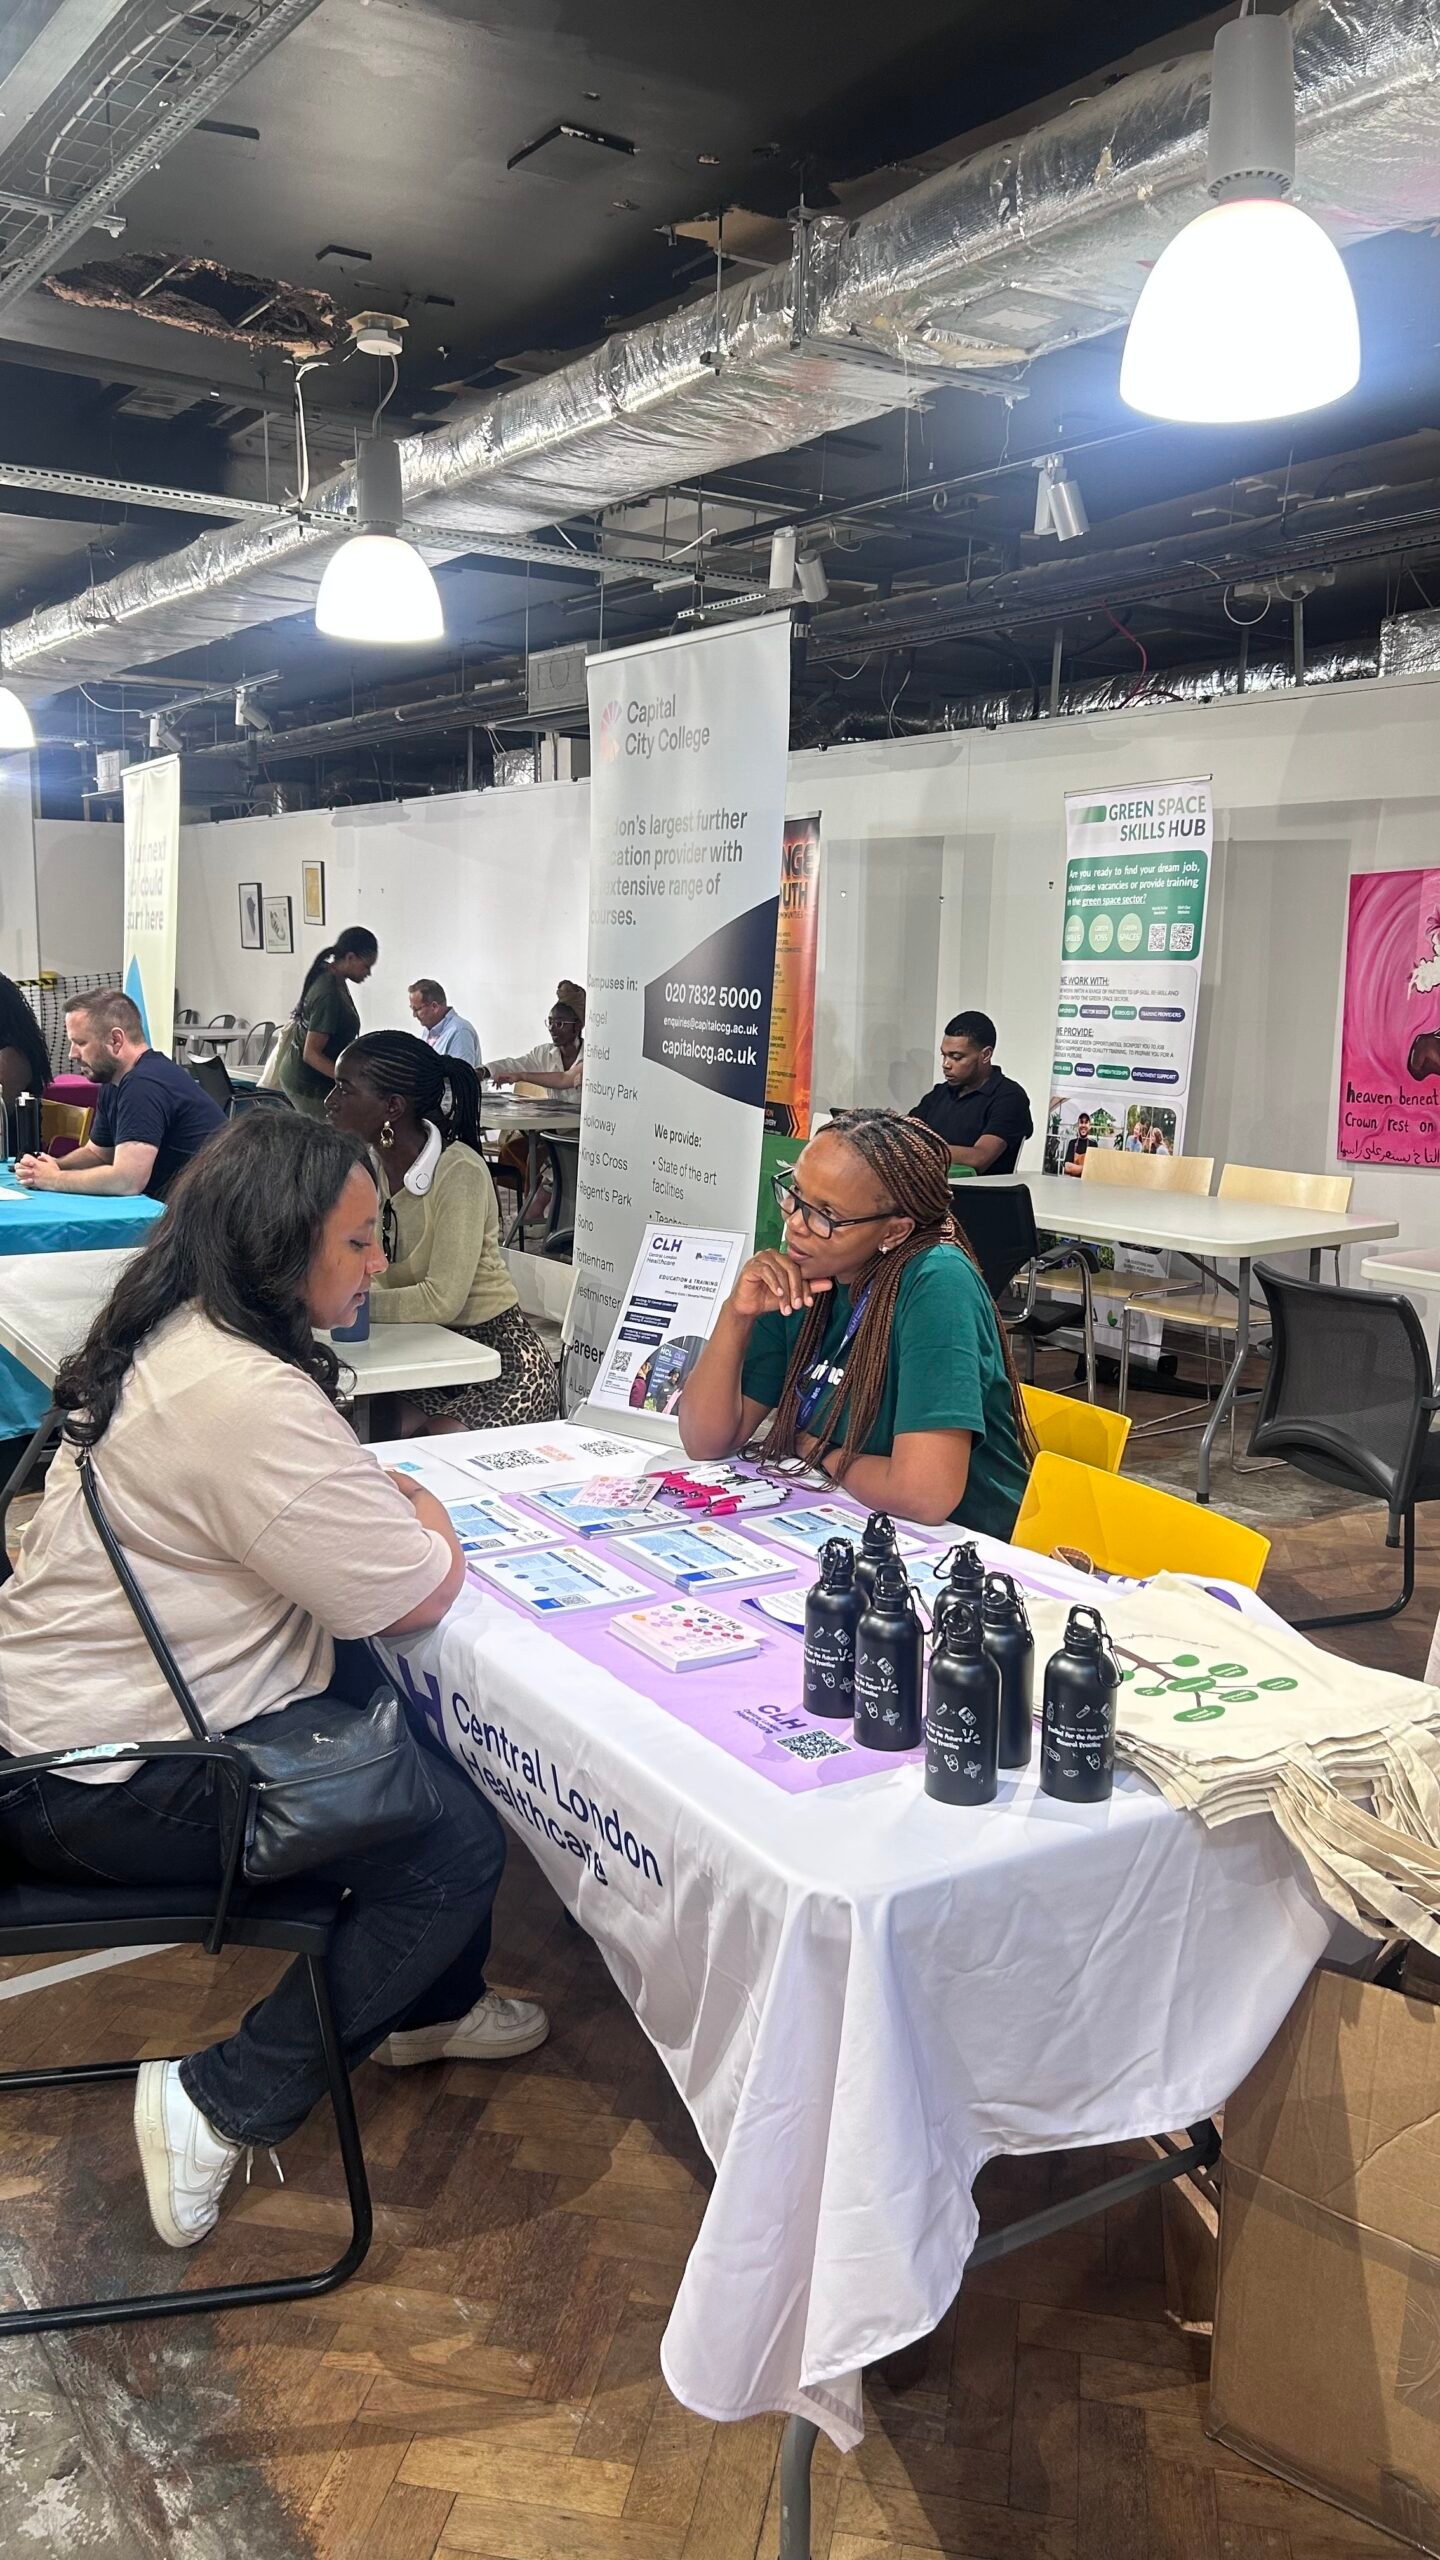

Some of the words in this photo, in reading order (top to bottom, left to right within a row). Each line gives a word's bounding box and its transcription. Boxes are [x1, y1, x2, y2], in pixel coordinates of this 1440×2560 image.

[627, 694, 676, 727] Capital
[625, 733, 655, 759] City
[658, 725, 710, 752] College
[1109, 800, 1154, 821] GREEN
[1158, 795, 1207, 816] SPACE
[650, 813, 693, 839] largest
[697, 808, 748, 831] further
[1120, 821, 1165, 841] SKILLS
[1168, 819, 1206, 837] HUB
[654, 842, 707, 870] provider
[710, 840, 743, 863] with
[1079, 870, 1091, 879] you
[1094, 867, 1113, 878] ready
[1115, 868, 1122, 876] to
[1124, 865, 1138, 875] find
[1140, 865, 1155, 876] your
[1158, 863, 1180, 873] dream
[1182, 861, 1200, 873] job,
[604, 875, 666, 897] extensive
[668, 878, 703, 900] range
[706, 873, 721, 895] of
[1097, 880, 1129, 891] vacancies
[1130, 881, 1138, 889] or
[1139, 878, 1165, 890] provide
[1166, 876, 1199, 889] training
[780, 882, 808, 911] UTH
[1082, 895, 1102, 907] green
[1103, 895, 1121, 906] space
[1123, 893, 1147, 905] sector?
[590, 908, 637, 926] courses.
[587, 974, 625, 991] Campuses
[626, 977, 638, 991] in:
[1069, 976, 1089, 986] WORK
[1090, 977, 1110, 987] WITH:
[665, 982, 686, 1004] 020
[689, 985, 717, 1007] 7832
[719, 987, 762, 1010] 5000
[588, 1010, 608, 1027] Angel
[663, 1016, 759, 1036] enquiries@capitalccg.ac.uk
[1063, 1028, 1094, 1038] PROVIDE:
[587, 1044, 610, 1061] Enfield
[662, 1038, 757, 1066] capitalccg.ac.uk
[585, 1078, 616, 1101] Finsbury
[617, 1083, 639, 1101] Park
[1346, 1081, 1393, 1104] heaven
[1399, 1085, 1439, 1106] beneat
[584, 1112, 617, 1136] Holloway
[1345, 1111, 1377, 1130] Crown
[1387, 1118, 1409, 1133] rest
[1419, 1121, 1434, 1133] on
[654, 1122, 668, 1140] We
[669, 1128, 703, 1149] provide:
[581, 1147, 601, 1166] King's
[602, 1152, 628, 1171] Cross
[657, 1156, 678, 1176] State
[679, 1163, 688, 1177] of
[689, 1165, 702, 1182] the
[703, 1170, 717, 1185] art
[579, 1180, 610, 1203] Regent's
[611, 1189, 633, 1207] Park
[652, 1178, 684, 1200] facilities
[577, 1214, 594, 1232] Soho
[652, 1237, 683, 1252] CLH
[576, 1247, 615, 1273] Tottenham
[658, 1274, 688, 1284] EDUCATION
[694, 1278, 719, 1287] TRAINING
[684, 1284, 717, 1293] WORKFORCE
[758, 1705, 808, 1729] CLH
[452, 1692, 548, 1795] Central
[551, 1763, 663, 1887] London
[459, 1743, 608, 1886] Healthcare
